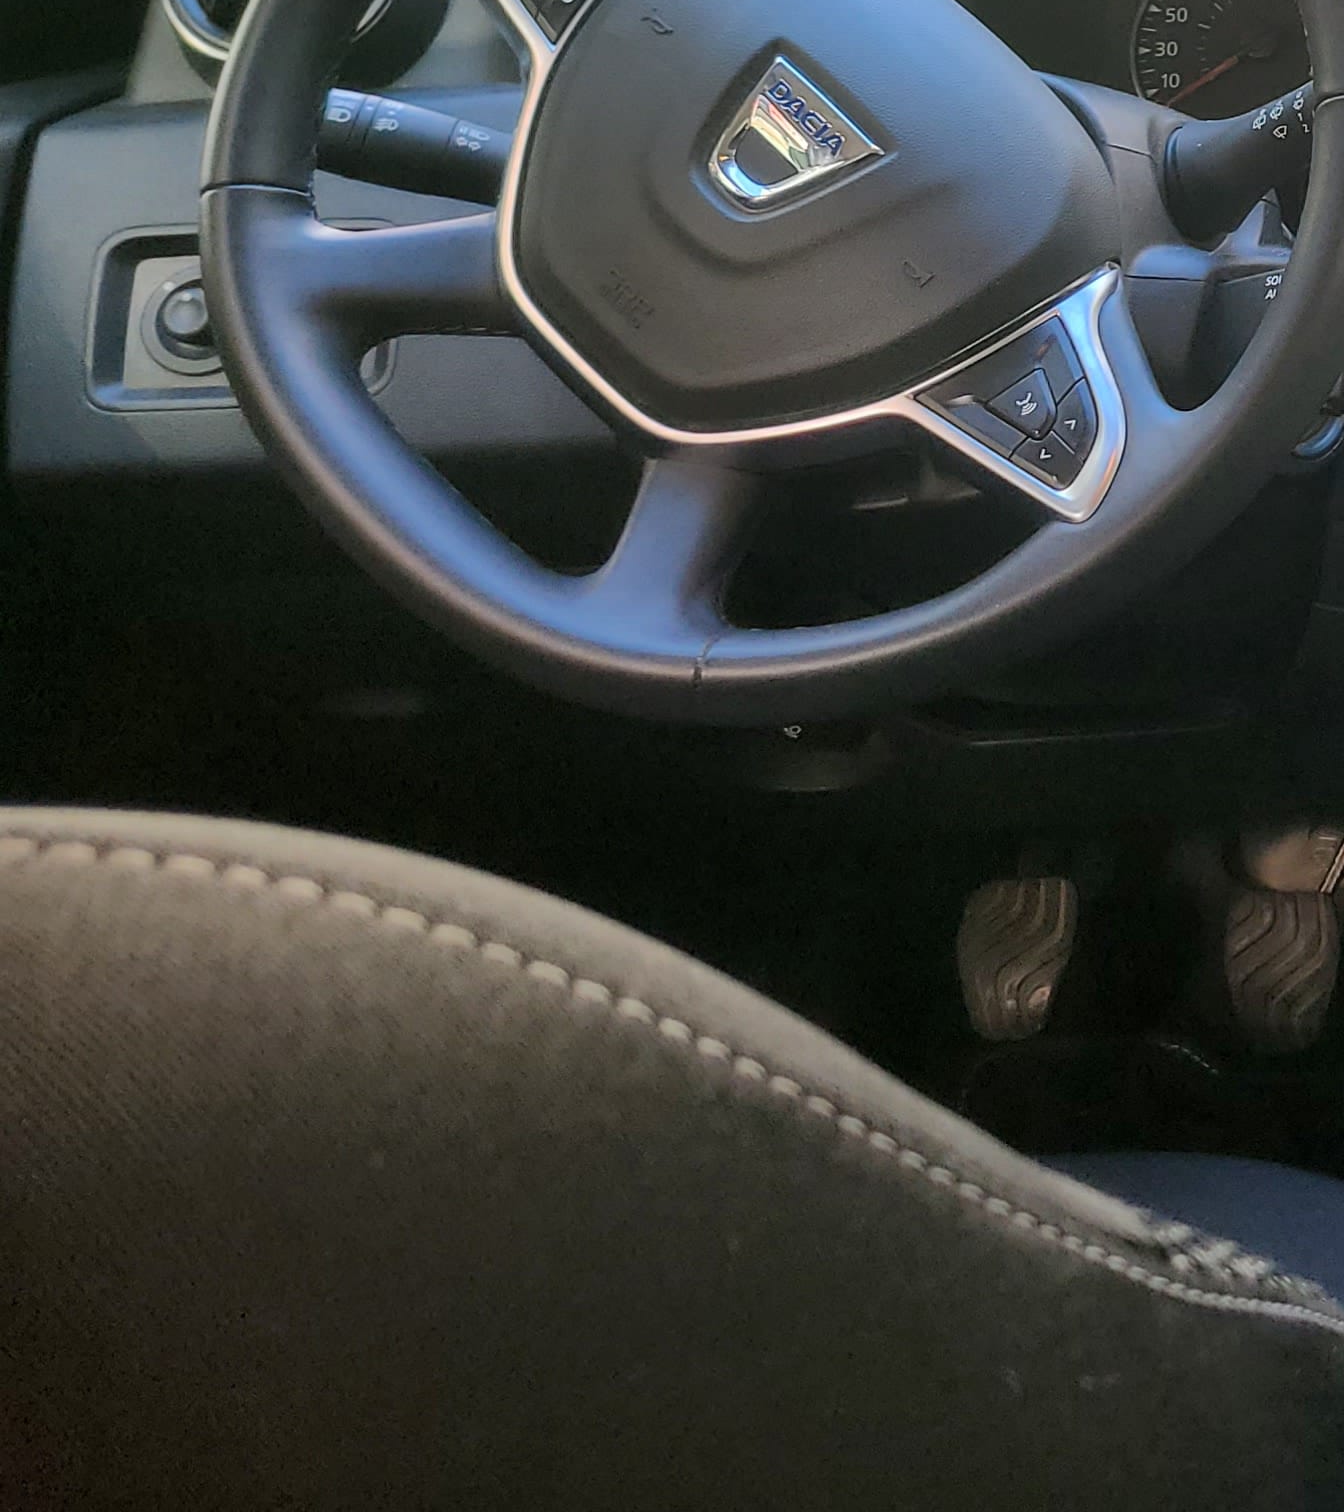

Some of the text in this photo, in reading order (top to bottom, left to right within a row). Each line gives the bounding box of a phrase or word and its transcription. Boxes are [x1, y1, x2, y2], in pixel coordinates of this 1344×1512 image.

[1165, 7, 1188, 22] 50
[1154, 41, 1178, 57] 30
[1161, 73, 1180, 88] 10
[766, 78, 846, 158] DACIA
